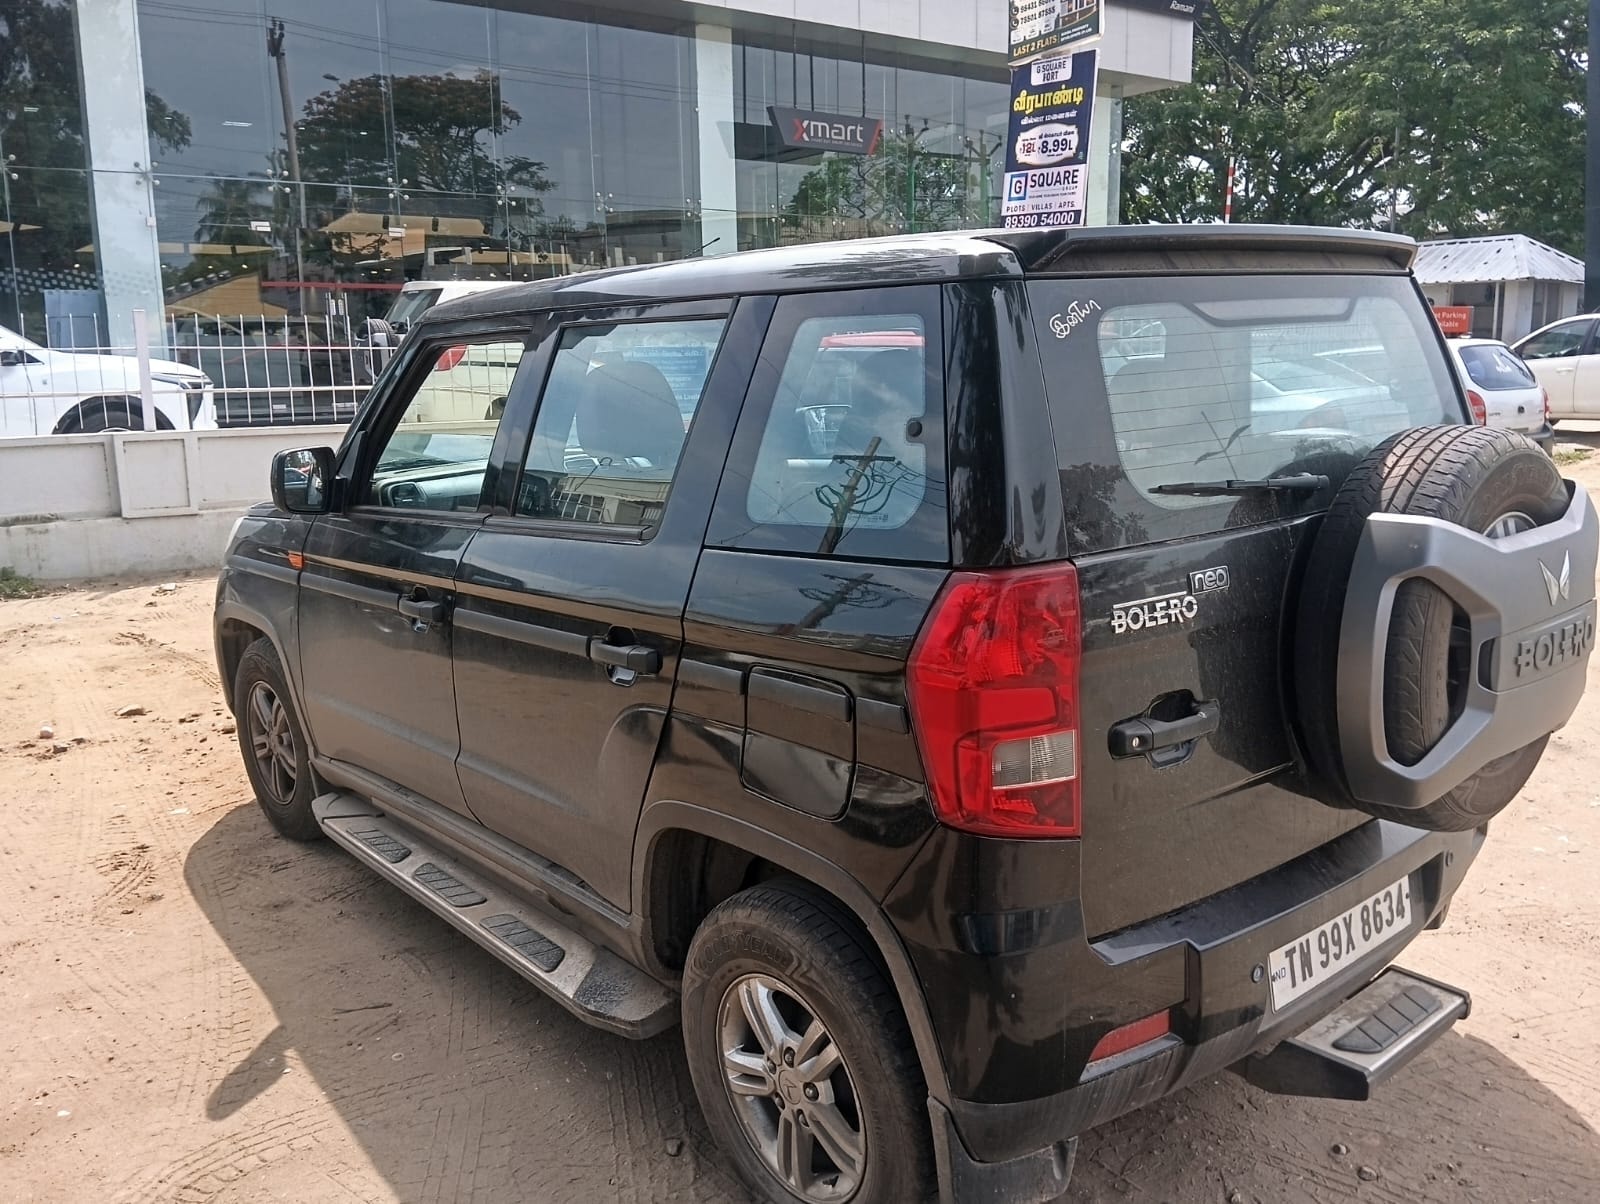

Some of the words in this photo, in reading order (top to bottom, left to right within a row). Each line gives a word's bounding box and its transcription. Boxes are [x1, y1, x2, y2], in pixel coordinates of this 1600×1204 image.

[1013, 43, 1029, 57] LAST
[1036, 34, 1057, 50] FLATS
[1036, 65, 1041, 74] G
[1042, 60, 1067, 73] SQUARE
[1043, 70, 1059, 82] FORT
[1013, 84, 1084, 114] வீரபாண்டி
[1014, 180, 1023, 194] G
[1029, 169, 1079, 188] SQUARE
[1006, 204, 1026, 213] PLOTS
[1031, 202, 1053, 211] VILLAS
[1005, 214, 1038, 229] 89390
[1040, 211, 1075, 226] 54000
[1441, 311, 1467, 320] Parking
[1194, 568, 1227, 590] neo
[1111, 595, 1198, 634] BOLERO
[1514, 615, 1593, 678] BOLERO
[1285, 938, 1313, 989] TN
[1317, 913, 1356, 969] 99X
[1360, 882, 1406, 942] 8634
